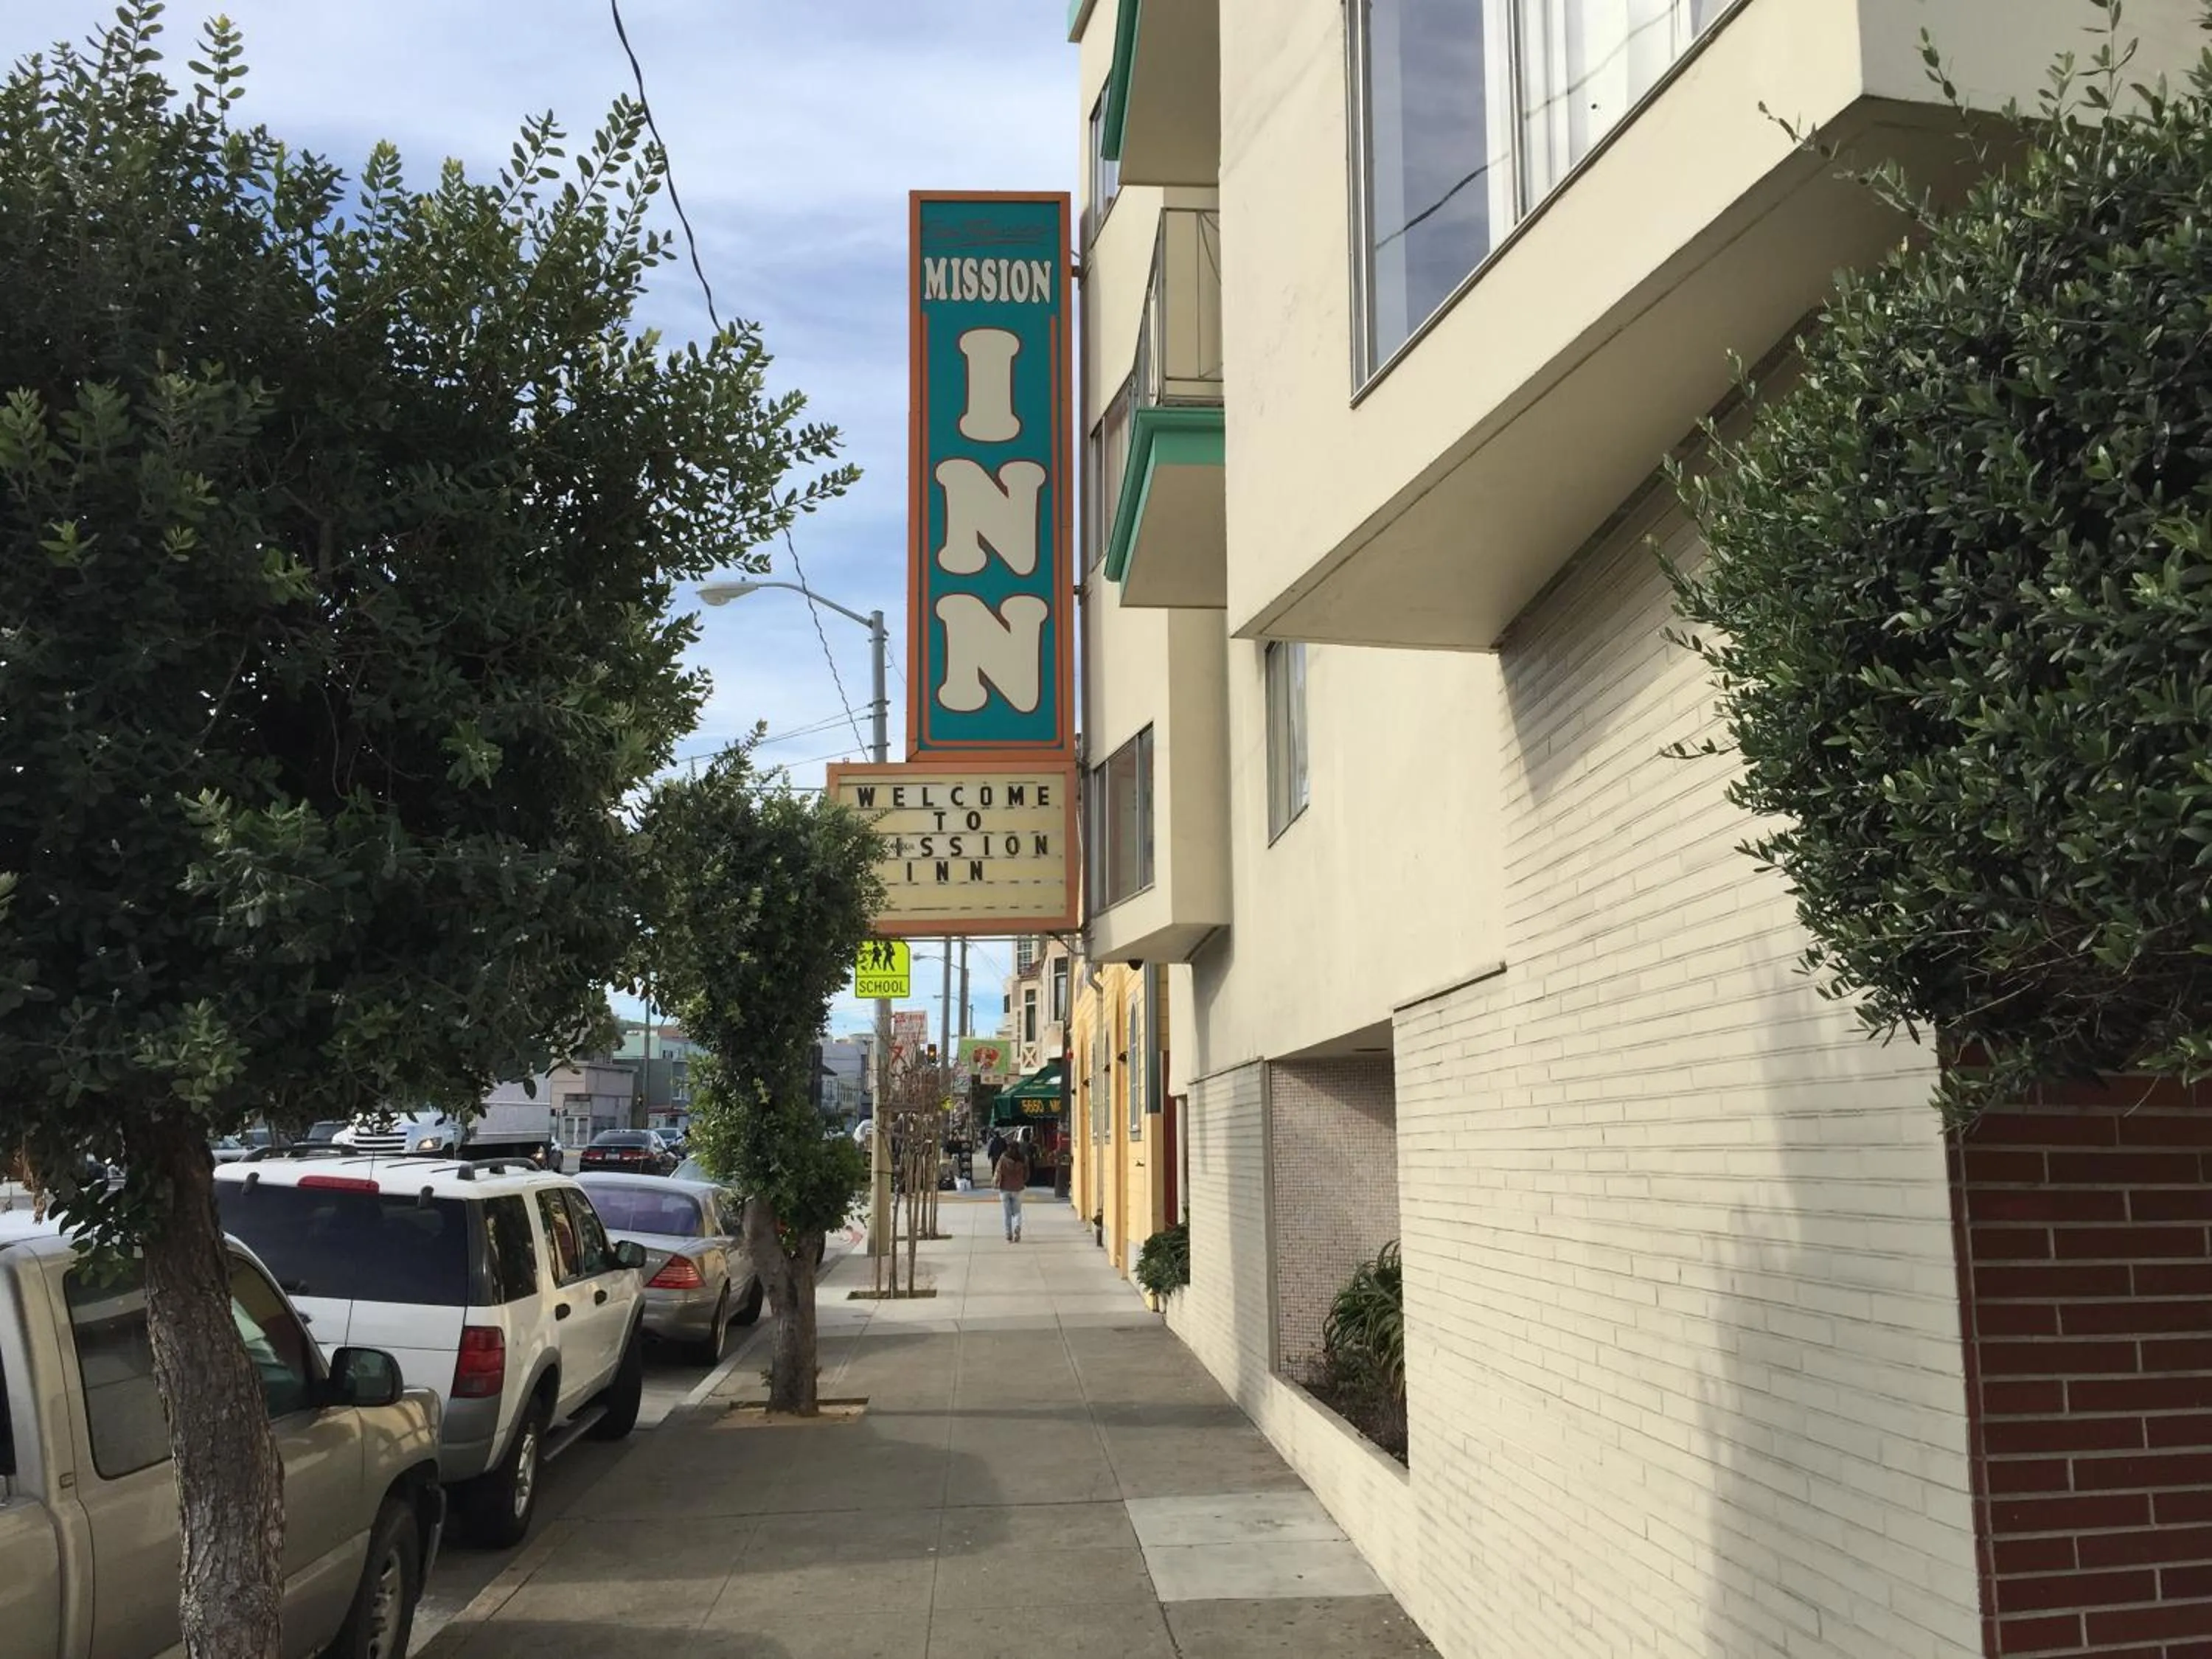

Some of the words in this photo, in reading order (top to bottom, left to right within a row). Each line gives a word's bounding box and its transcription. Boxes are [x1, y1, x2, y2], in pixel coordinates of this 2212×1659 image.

[923, 257, 1052, 305] MISSION
[934, 327, 1049, 714] INN
[857, 785, 1050, 808] WELCOME
[933, 810, 982, 832] TO
[894, 835, 1049, 858] ISSION
[905, 860, 984, 883] INN
[859, 979, 906, 993] SCHOOL
